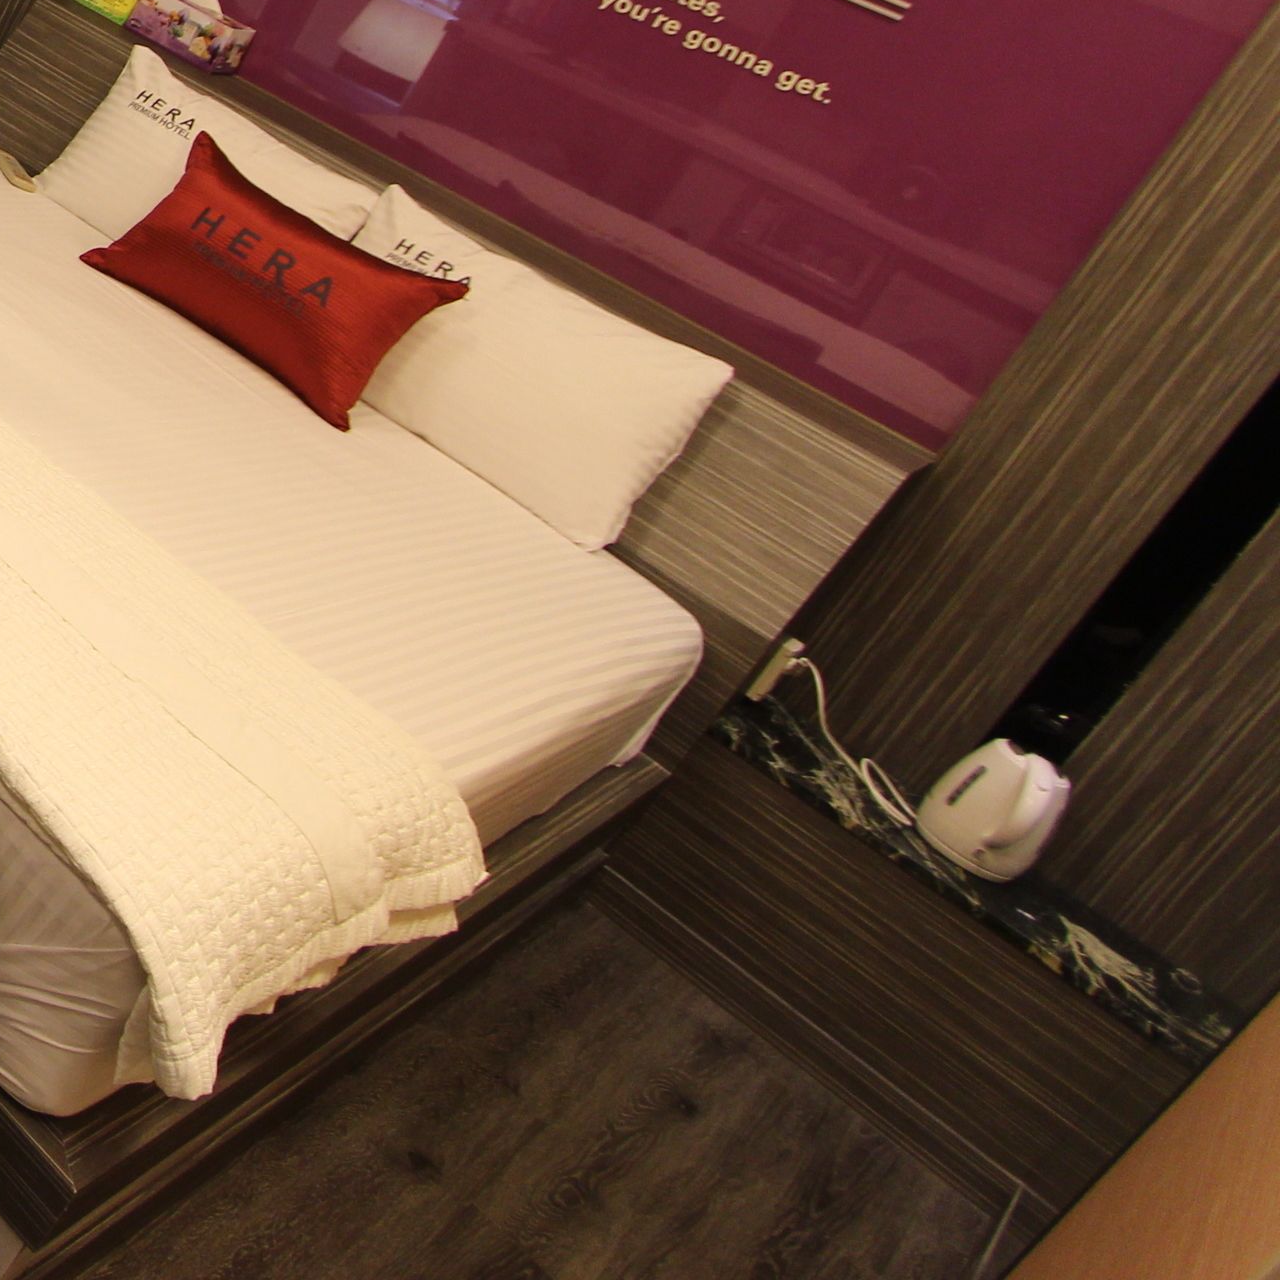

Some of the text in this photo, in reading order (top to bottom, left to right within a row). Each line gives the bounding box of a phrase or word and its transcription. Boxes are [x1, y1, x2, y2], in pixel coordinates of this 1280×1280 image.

[682, 29, 774, 76] gonna
[774, 70, 832, 104] get.
[136, 90, 196, 130] HERA
[158, 117, 191, 140] HOTEL
[191, 207, 333, 308] HERA
